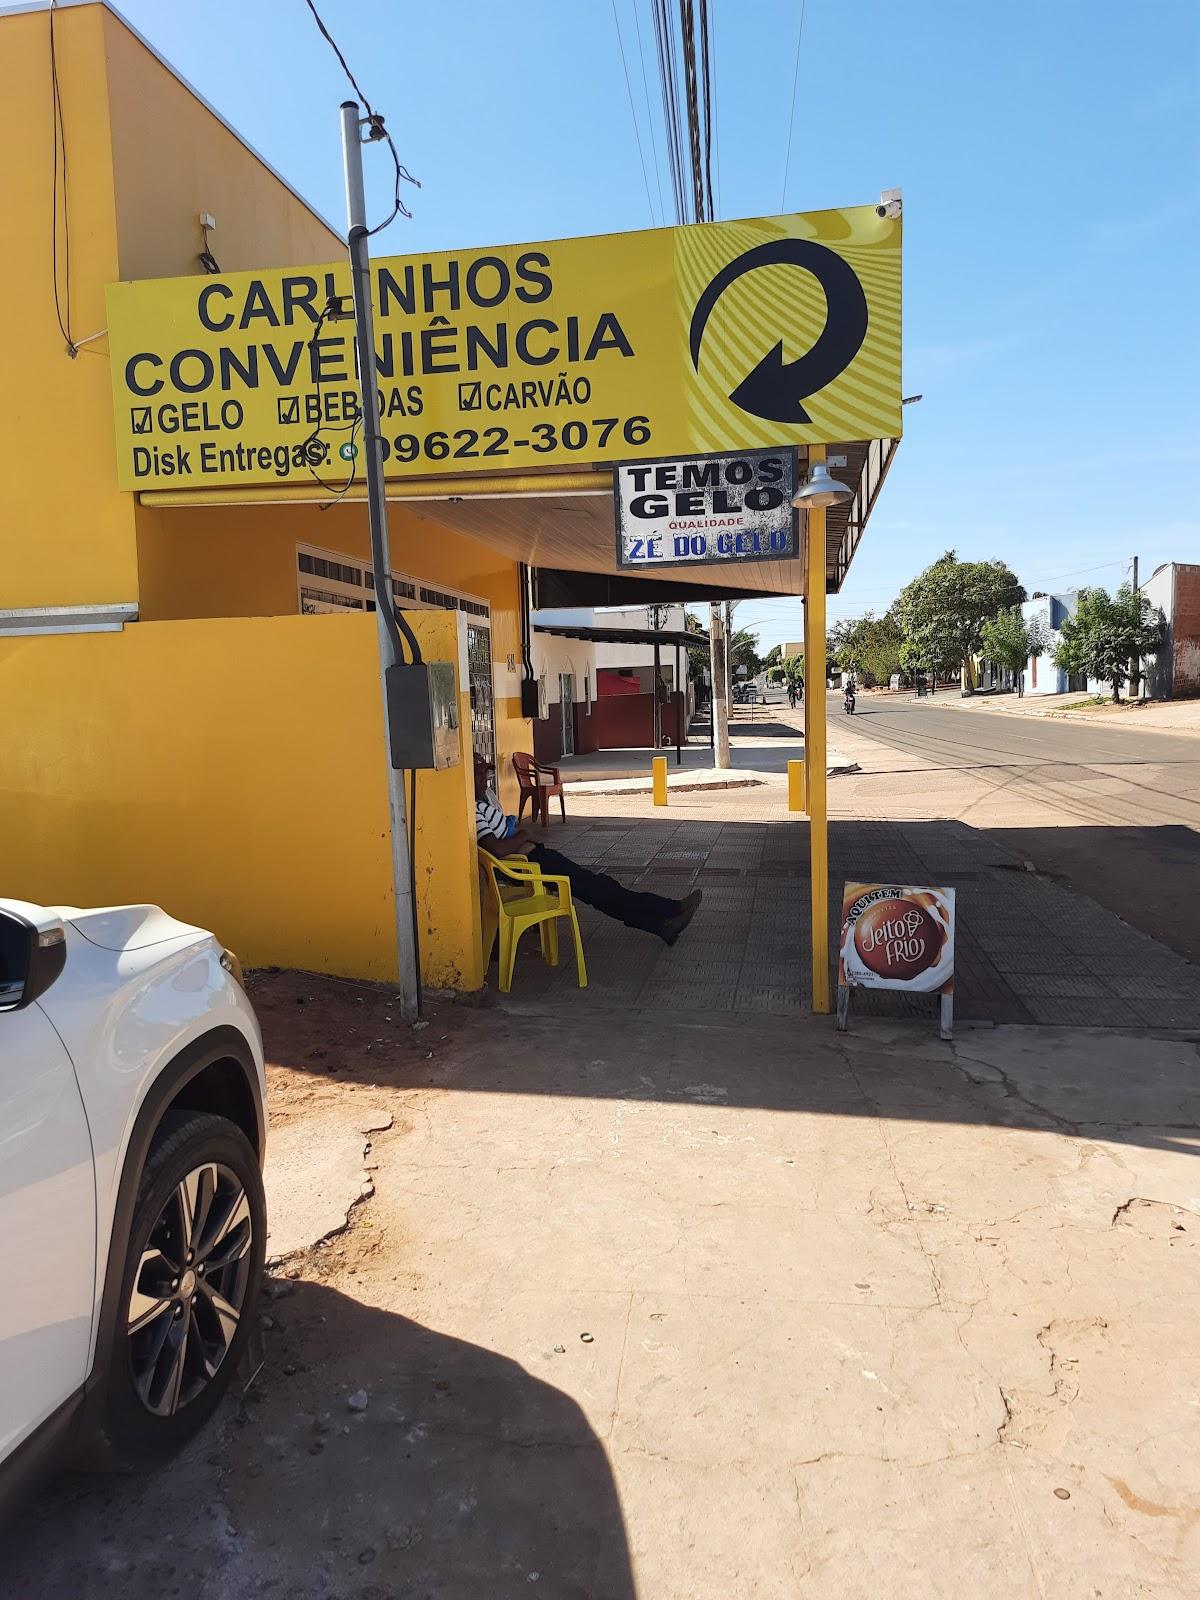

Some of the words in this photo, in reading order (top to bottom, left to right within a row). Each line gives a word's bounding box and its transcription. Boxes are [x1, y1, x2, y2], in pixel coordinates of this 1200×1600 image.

[198, 252, 552, 332] CARLNHOS
[486, 372, 591, 410] CARVÃO
[158, 399, 244, 434] GELO
[133, 444, 192, 477] Disk
[200, 442, 332, 477] Entregas:
[627, 458, 783, 492] TEMOS
[629, 487, 784, 519] GELO
[668, 517, 744, 530] QUALIDADE
[628, 531, 663, 560] ZÉ
[673, 532, 707, 557] DO
[717, 528, 787, 555] GELO
[846, 894, 873, 926] AQUI
[871, 889, 901, 900] TEM
